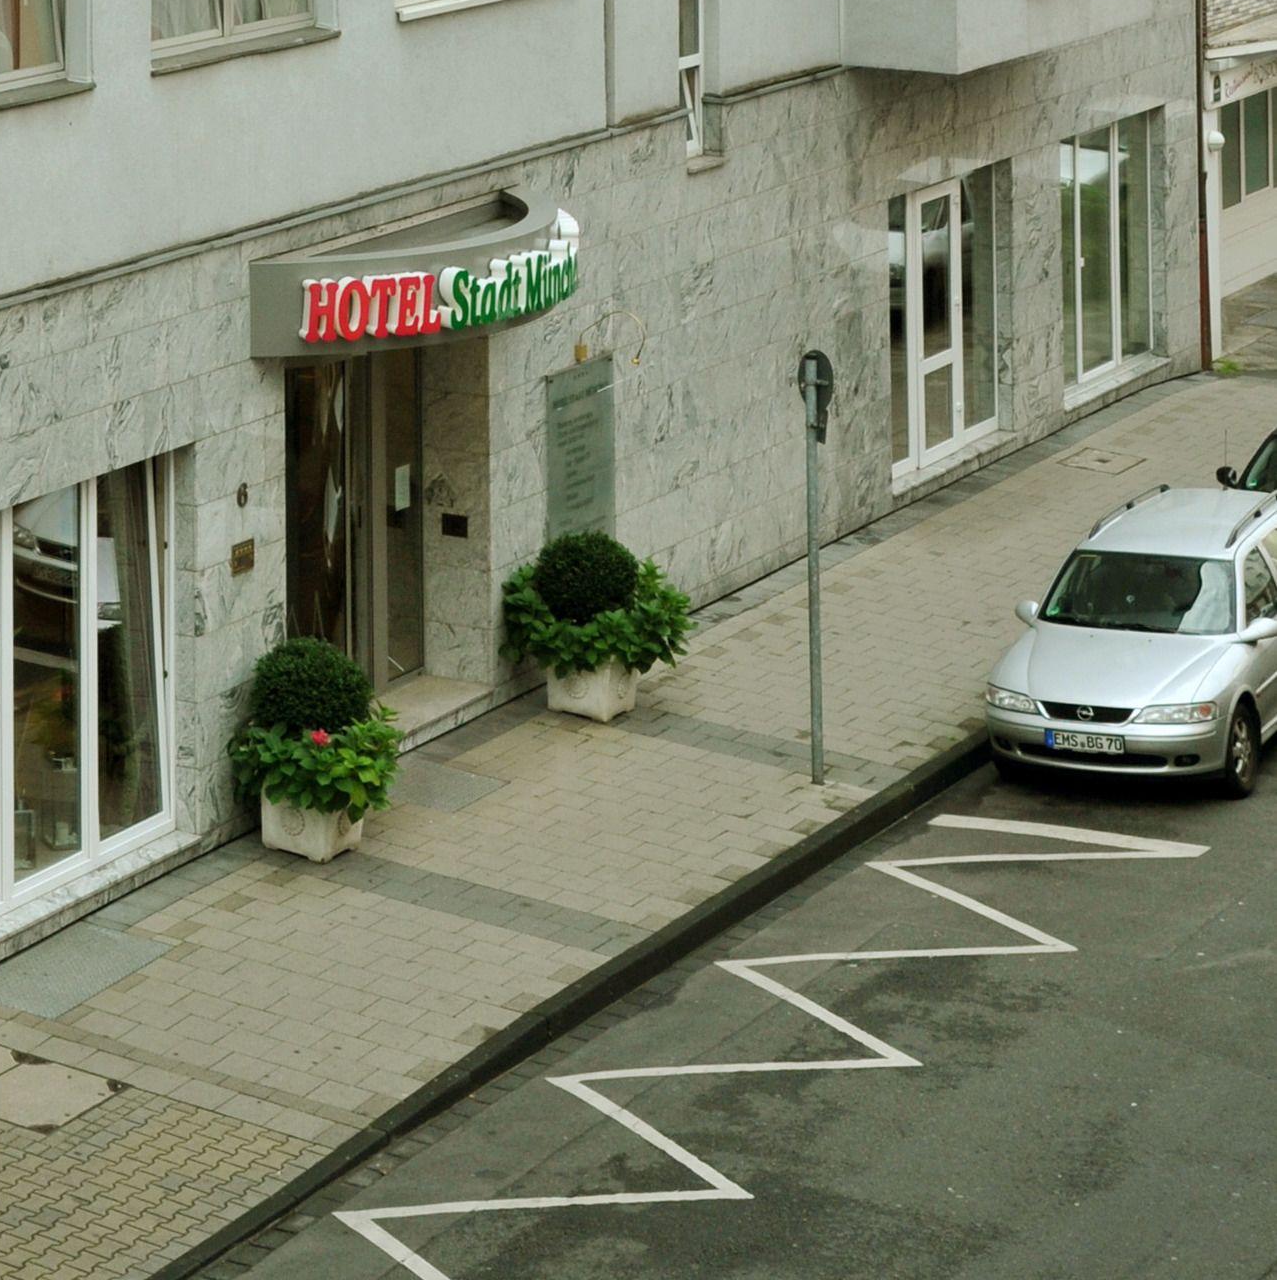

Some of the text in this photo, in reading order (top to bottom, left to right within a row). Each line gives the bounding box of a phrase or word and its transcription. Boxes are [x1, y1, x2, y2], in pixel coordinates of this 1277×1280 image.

[304, 241, 578, 343] HOTEL Stadt Münch
[236, 482, 248, 508] 6
[1053, 732, 1123, 751] EMS BG 70
